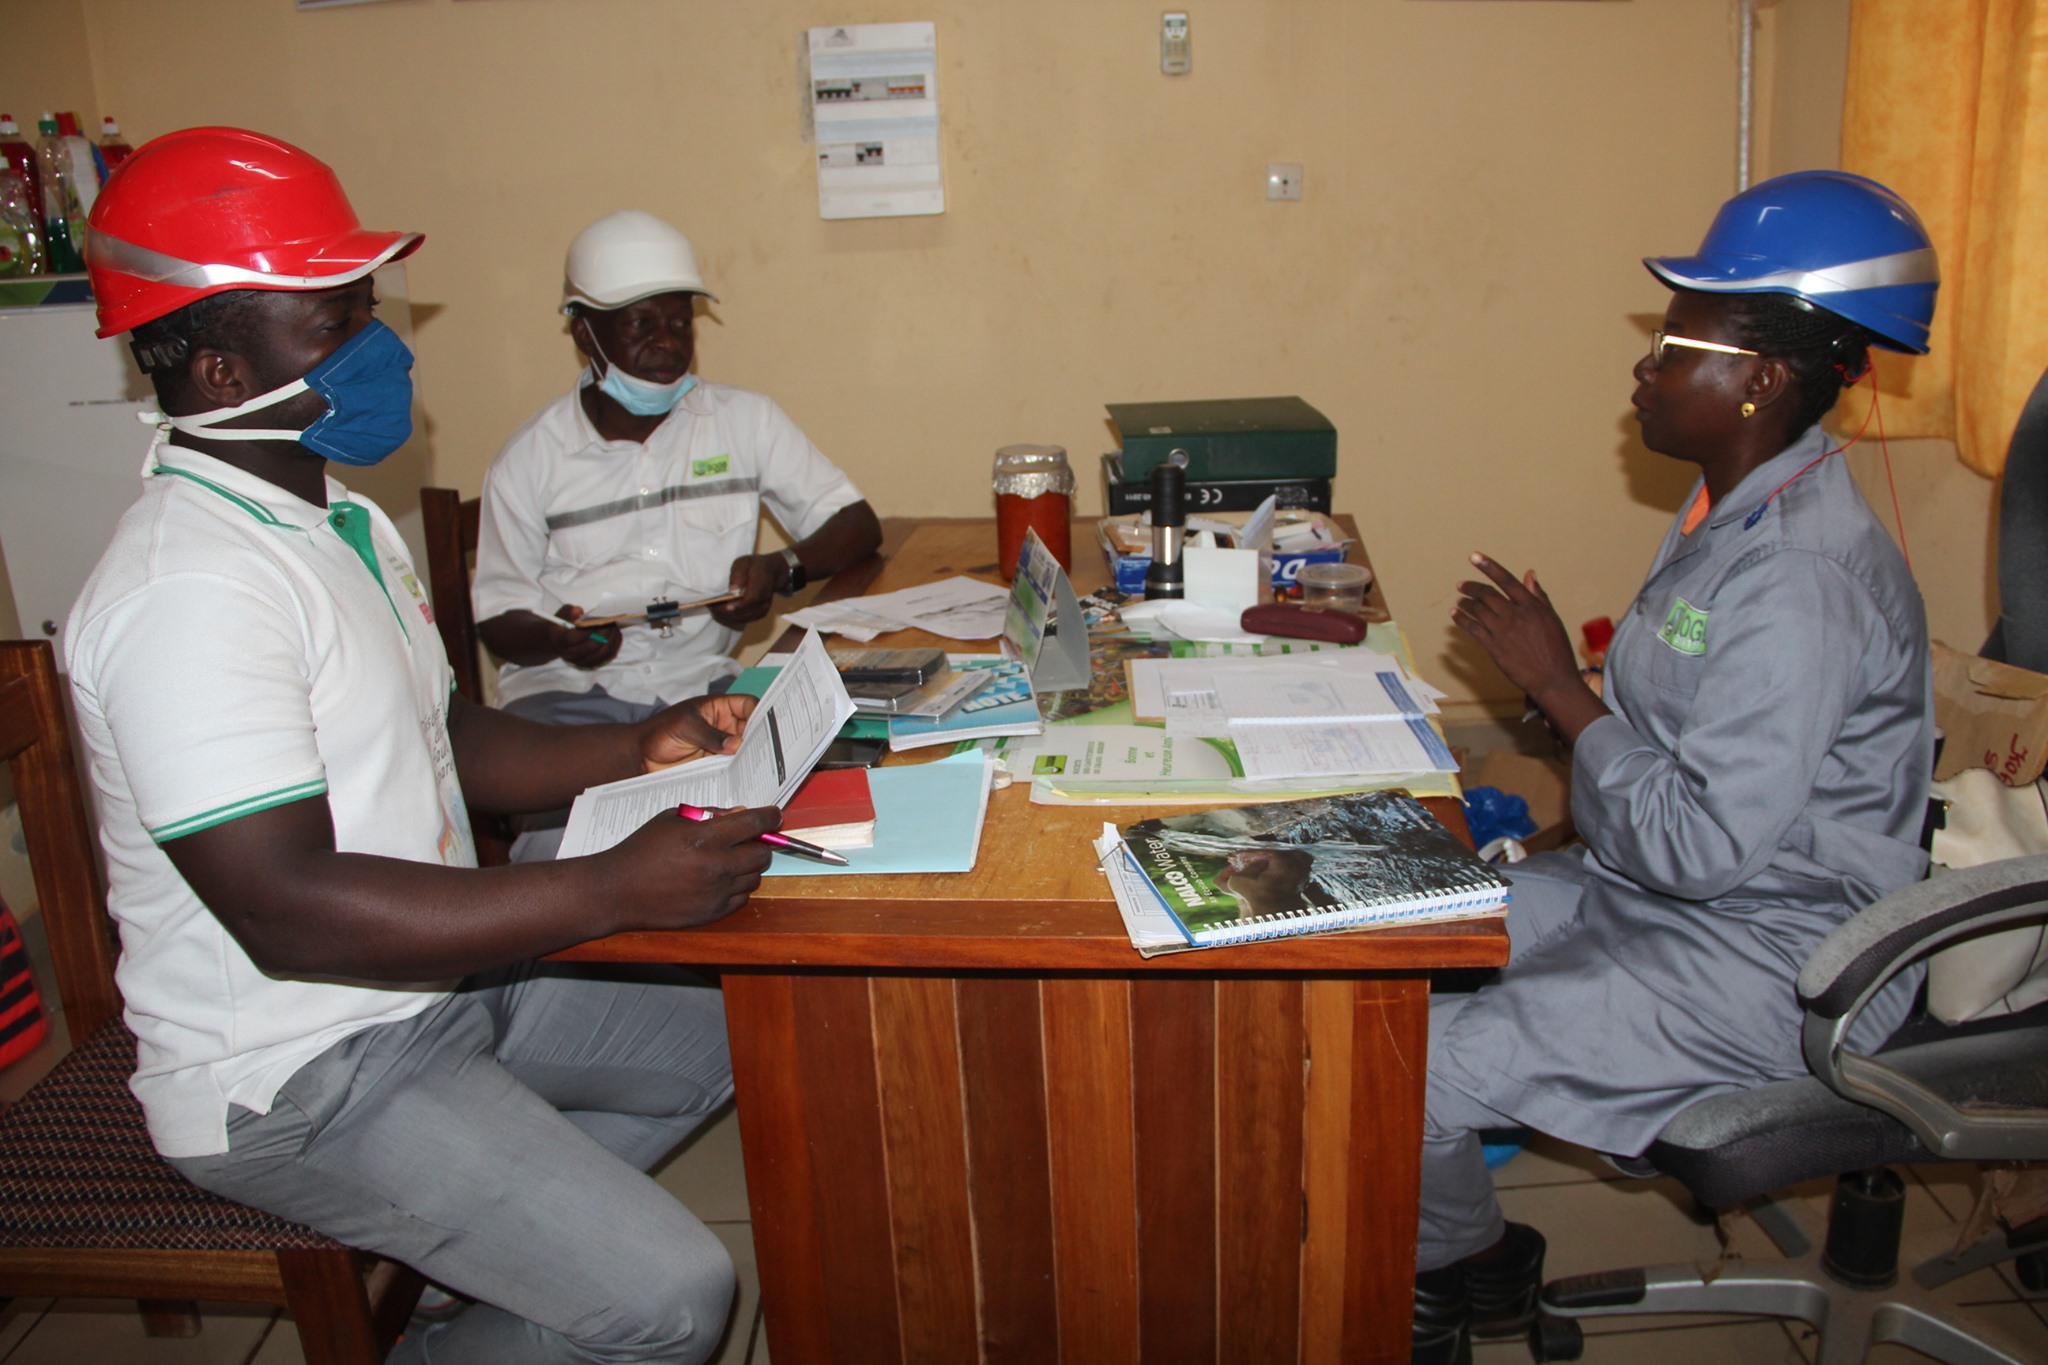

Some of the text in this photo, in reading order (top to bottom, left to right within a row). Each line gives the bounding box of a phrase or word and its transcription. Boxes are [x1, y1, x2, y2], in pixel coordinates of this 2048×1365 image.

[963, 692, 1028, 712] NOTE
[1145, 838, 1206, 907] NALCO Water
[1179, 856, 1198, 878] Company
